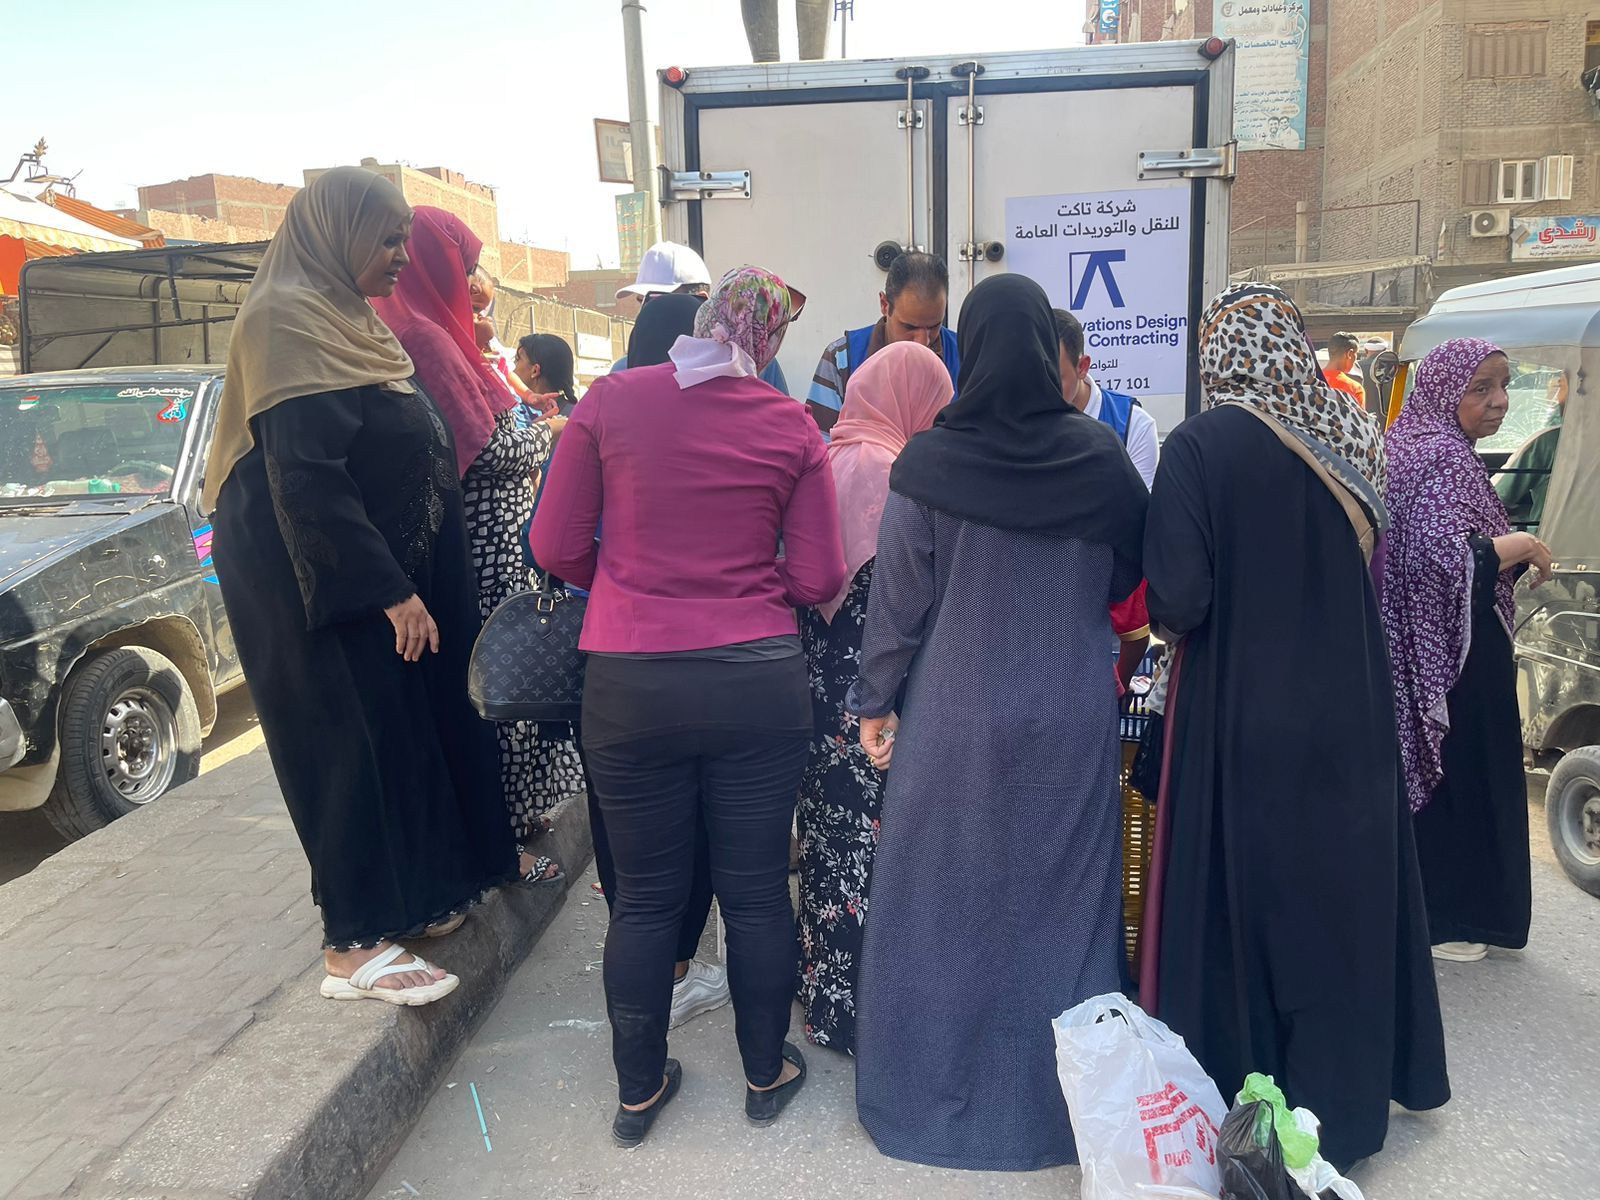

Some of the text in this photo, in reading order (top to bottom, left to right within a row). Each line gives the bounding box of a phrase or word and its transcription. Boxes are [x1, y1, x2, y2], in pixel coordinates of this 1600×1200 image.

[1057, 199, 1137, 217] شركة تاكت
[1015, 216, 1180, 239] للنقل والتوريدات العامة
[1136, 314, 1187, 331] Design
[1088, 330, 1179, 348] Contracting
[1089, 359, 1118, 371] للتواص
[1106, 379, 1122, 391] 17
[1126, 377, 1151, 390] 101
